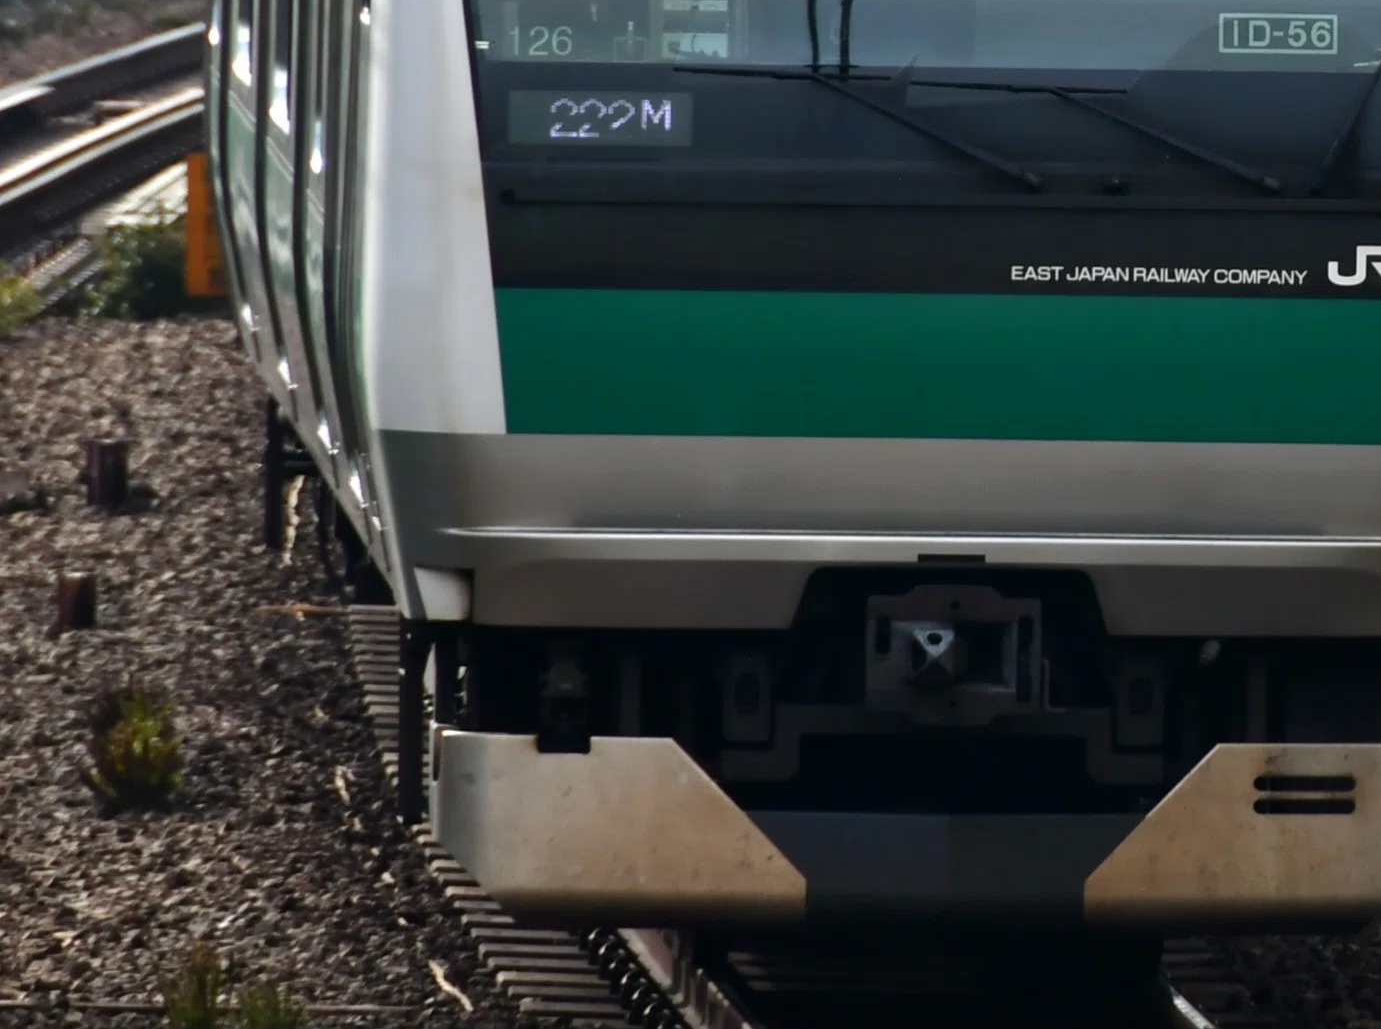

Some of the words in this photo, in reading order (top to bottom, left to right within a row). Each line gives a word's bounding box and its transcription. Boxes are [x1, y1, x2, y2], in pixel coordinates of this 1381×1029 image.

[507, 25, 573, 57] 126
[1232, 19, 1332, 48] ID-56
[550, 97, 672, 138] 222M
[1010, 265, 1064, 281] EAST
[1066, 266, 1130, 282] JAPAN
[1133, 267, 1211, 283] RAILWAY
[1214, 269, 1308, 285] COMPANY
